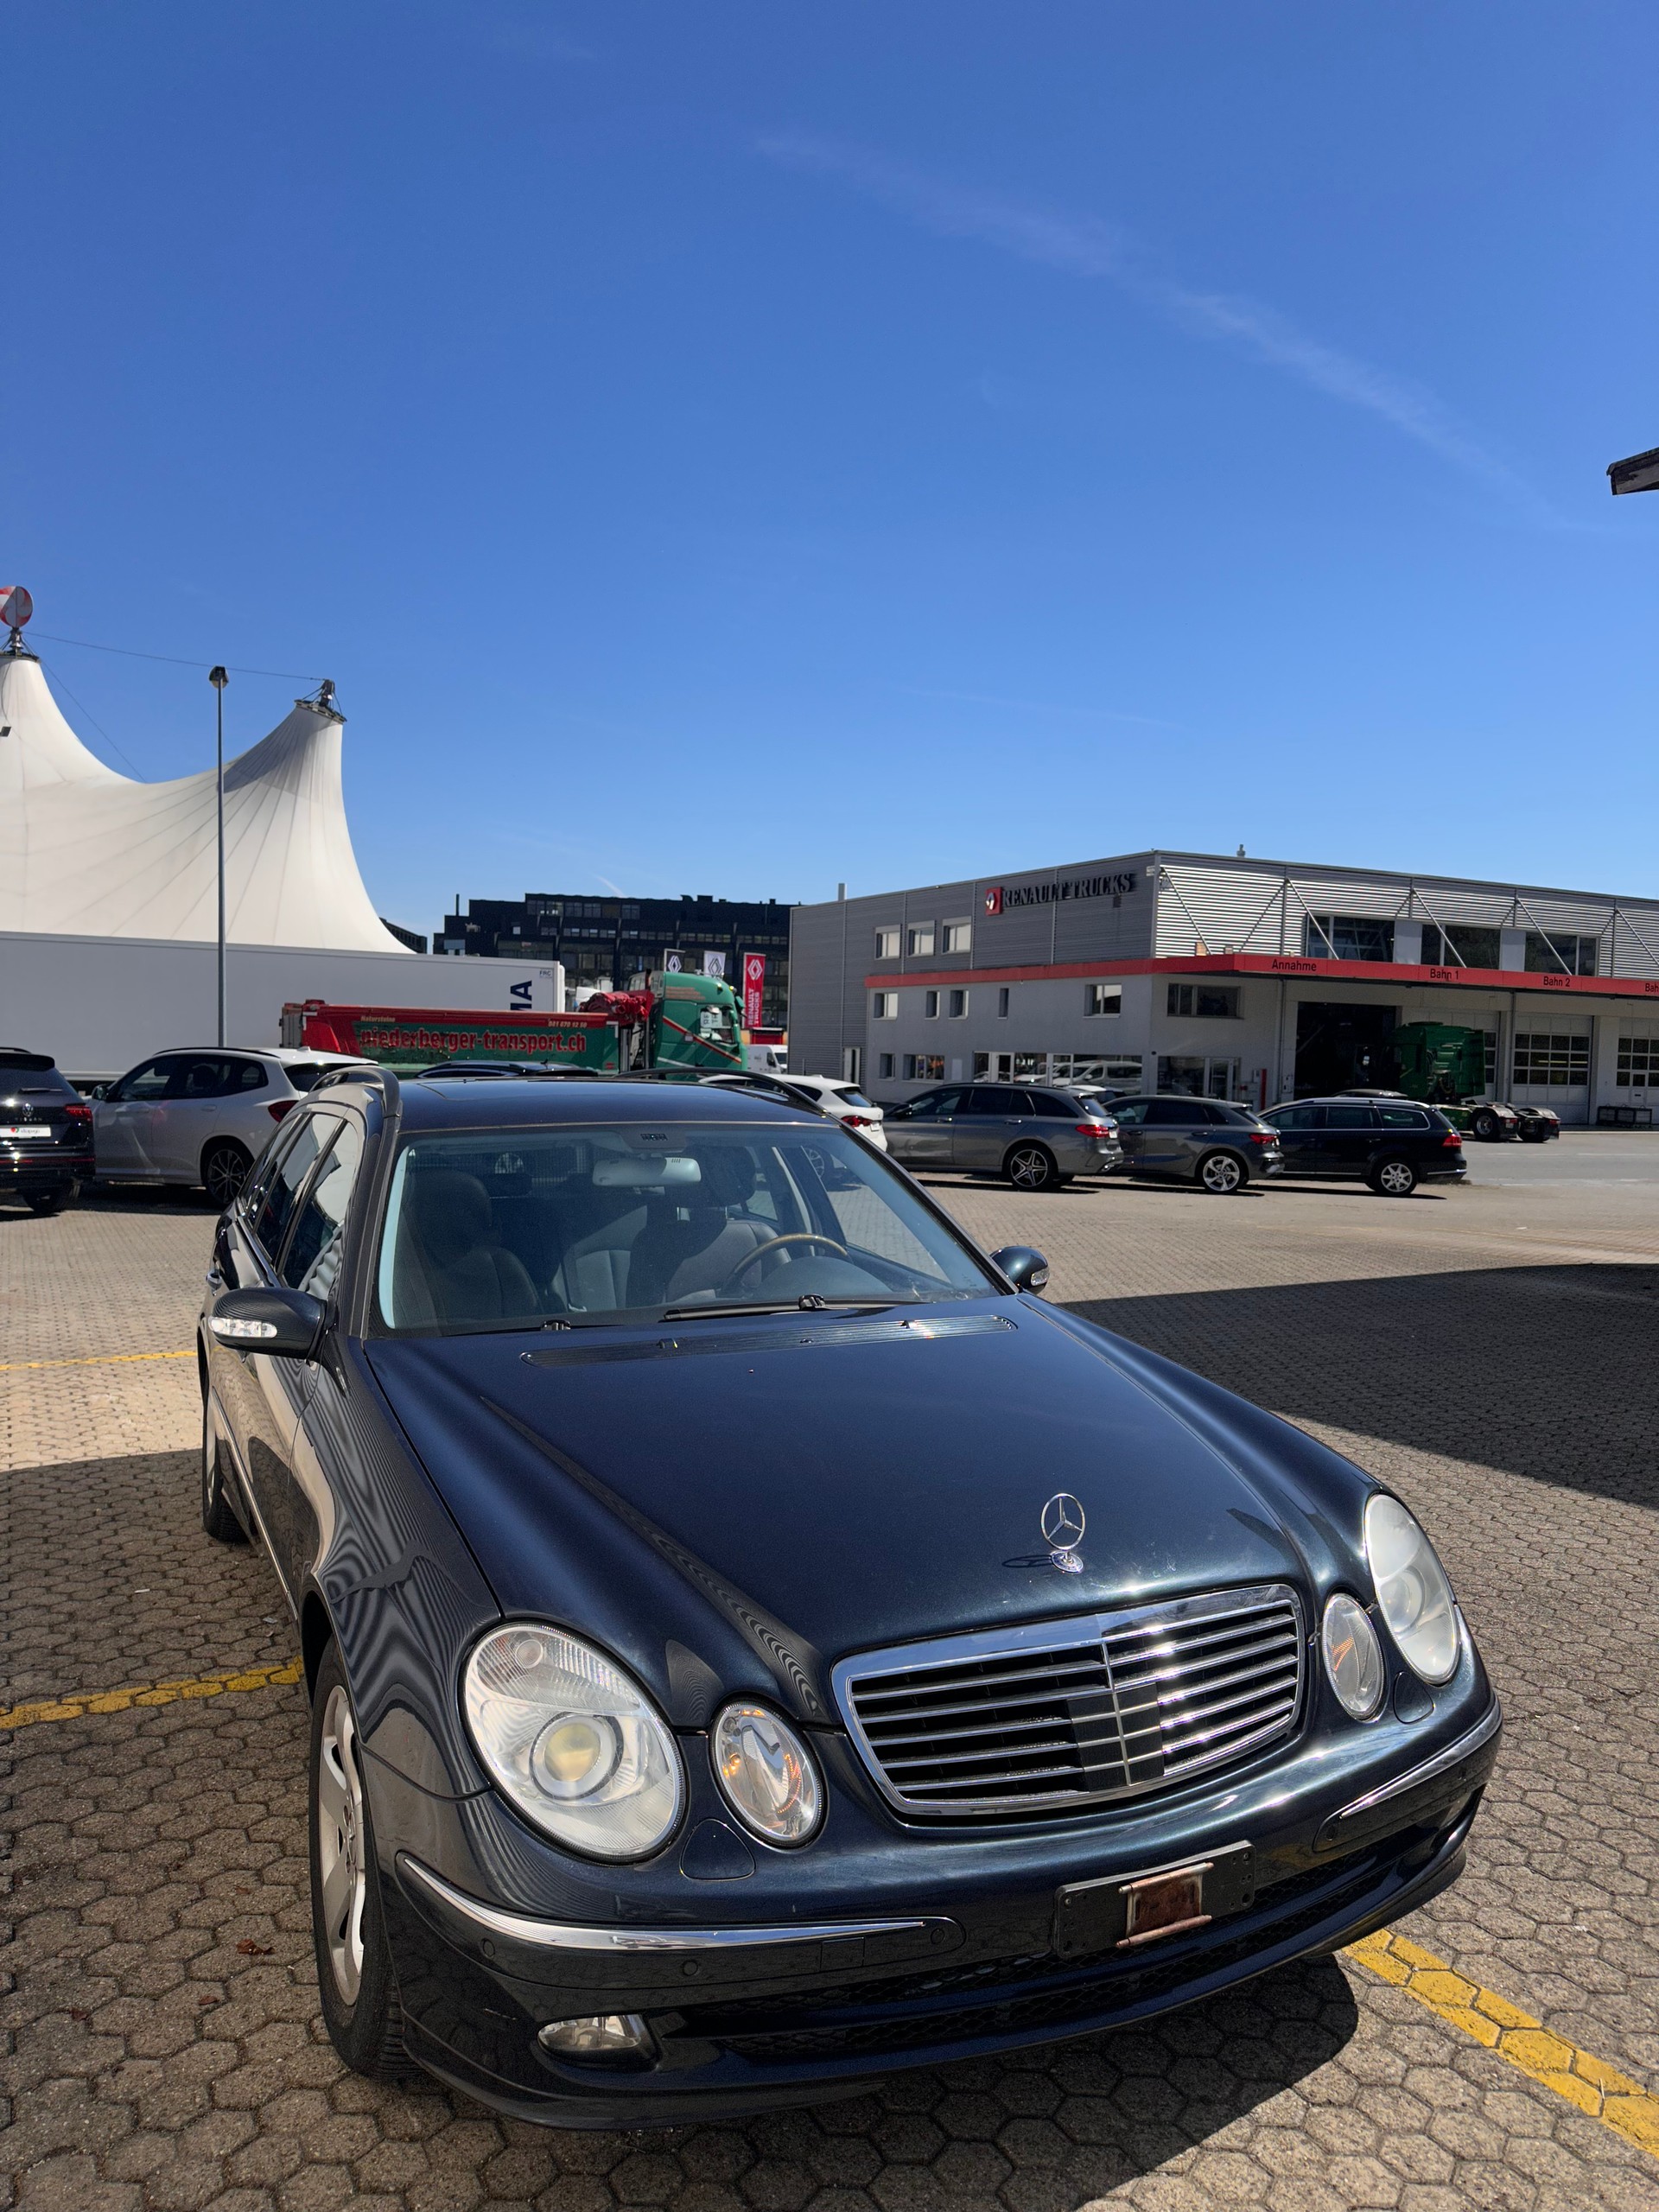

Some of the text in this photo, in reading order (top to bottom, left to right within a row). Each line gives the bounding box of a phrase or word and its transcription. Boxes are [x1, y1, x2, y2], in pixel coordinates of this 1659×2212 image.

[1002, 874, 1133, 906] RENAULT TRUCKS
[1272, 958, 1317, 971] Annahme
[1430, 969, 1459, 980] Bahn 1
[1543, 976, 1571, 988] Bahn 2
[359, 1027, 587, 1054] niederberger-transport.ch
